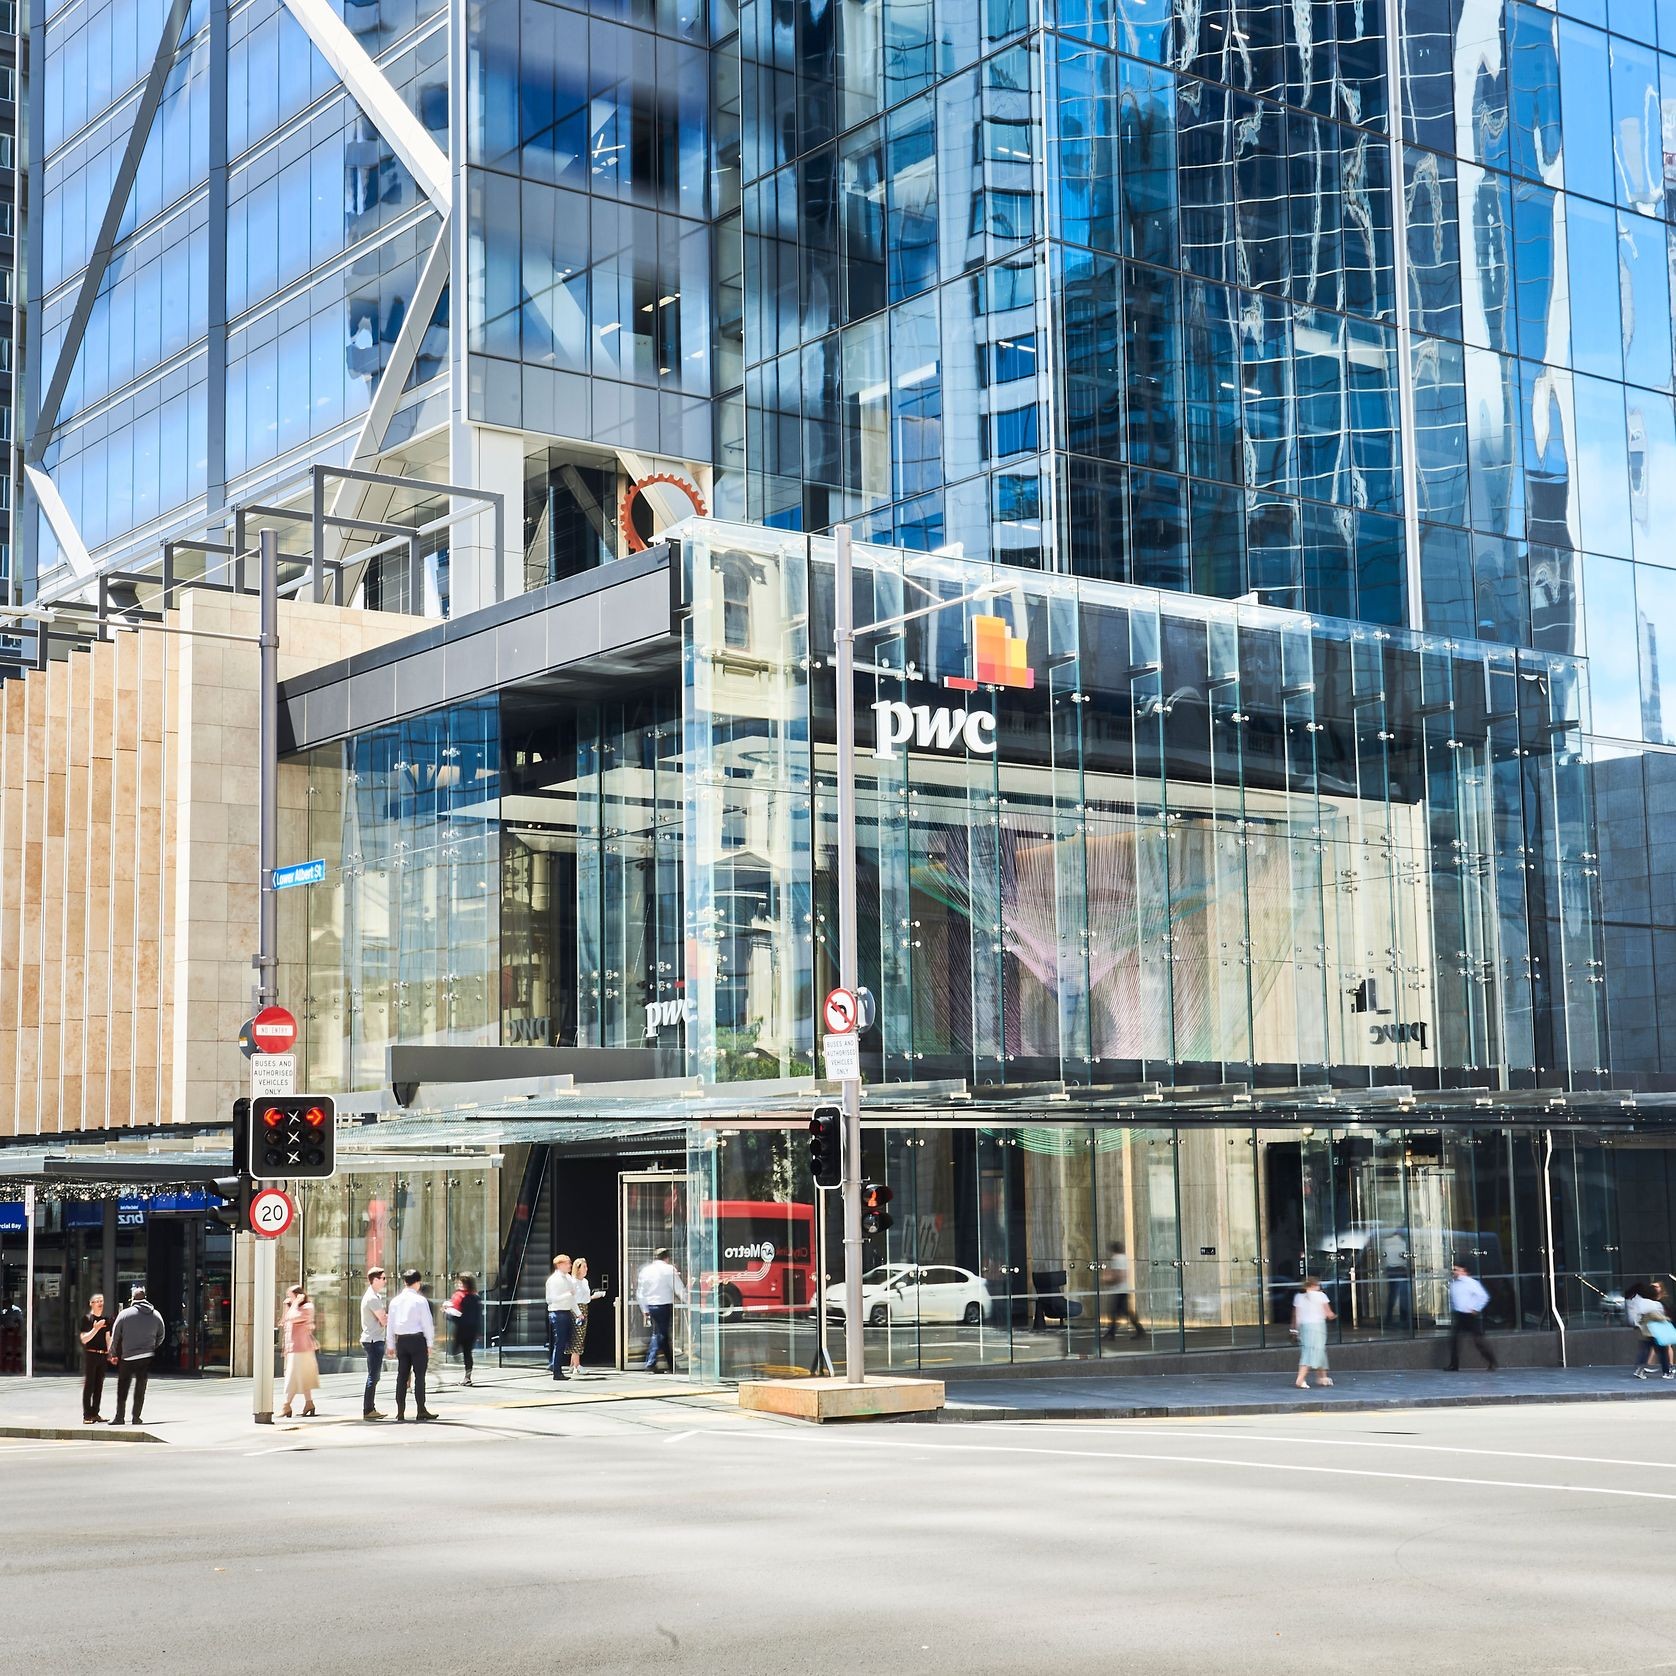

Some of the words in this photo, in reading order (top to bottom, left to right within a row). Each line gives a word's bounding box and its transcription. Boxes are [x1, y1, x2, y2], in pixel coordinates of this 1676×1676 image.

[870, 700, 998, 761] pwc
[294, 865, 314, 882] Albert
[314, 863, 323, 879] St
[644, 998, 698, 1038] pwc
[261, 1026, 269, 1034] NO
[254, 1069, 293, 1077] AUTHORISED
[264, 1088, 282, 1096] ONLY
[261, 1204, 284, 1223] 20
[11, 1222, 22, 1230] Bay
